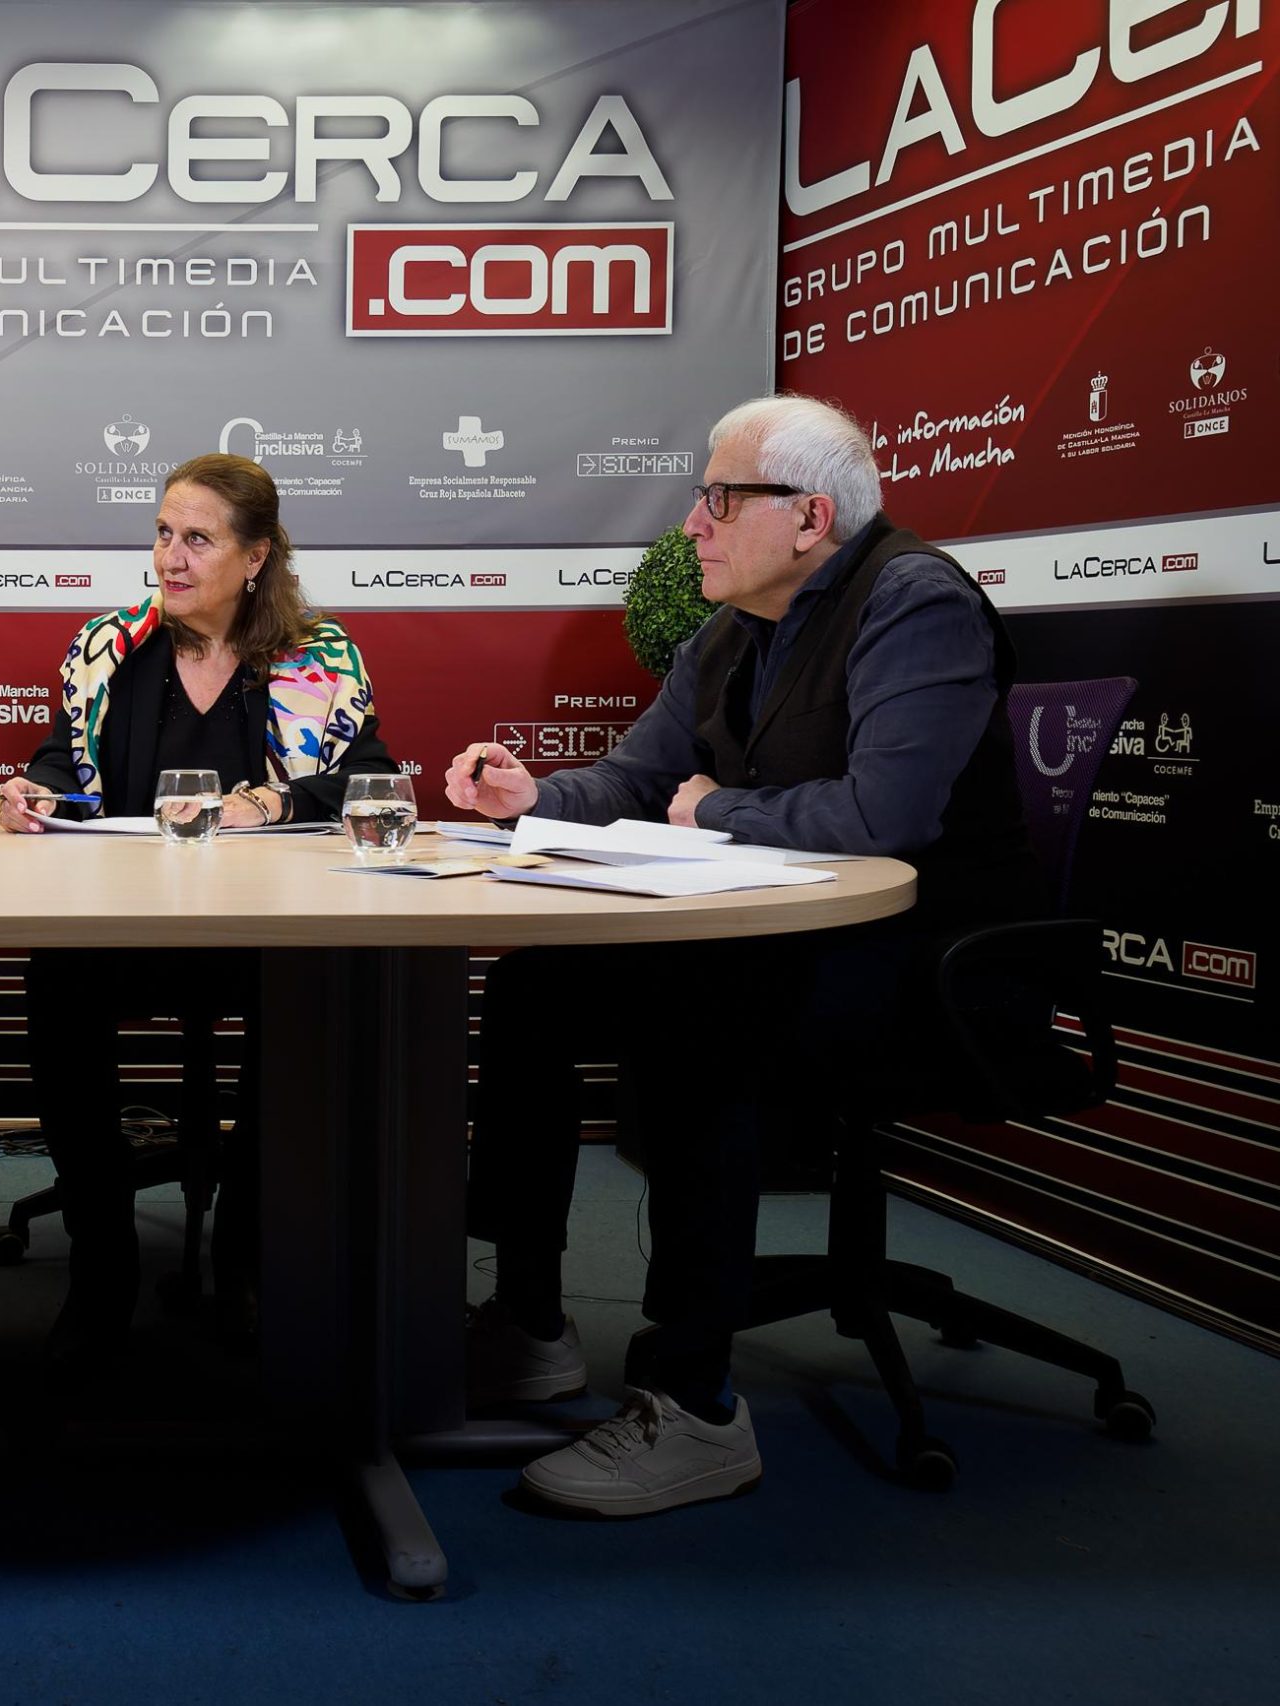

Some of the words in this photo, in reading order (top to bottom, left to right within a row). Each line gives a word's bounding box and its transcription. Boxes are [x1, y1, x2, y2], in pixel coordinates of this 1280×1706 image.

[784, 239, 905, 308] GRUPO
[929, 117, 1260, 260] MULTIMEDIA
[783, 322, 826, 361] DE
[846, 204, 1210, 343] COMUNICACIÓN
[1168, 388, 1248, 414] SOLIDARIOS
[897, 394, 1025, 445] información
[1197, 420, 1226, 433] ONCE
[294, 432, 324, 441] Mancha
[612, 437, 659, 446] PREMIO
[255, 441, 324, 456] inclusiva
[602, 455, 688, 473] SICMAN
[930, 437, 1015, 477] Mancha
[75, 462, 178, 476] SOLIDARIOS
[408, 475, 442, 487] Empresa
[490, 475, 536, 487] Responsable
[114, 490, 151, 500] ONCE
[419, 489, 438, 499] Cruz
[439, 489, 457, 500] Roja
[554, 694, 637, 708] PREMIO
[1153, 764, 1193, 776] COCEMFE
[1089, 806, 1100, 819] de
[1101, 806, 1166, 824] Comunicación
